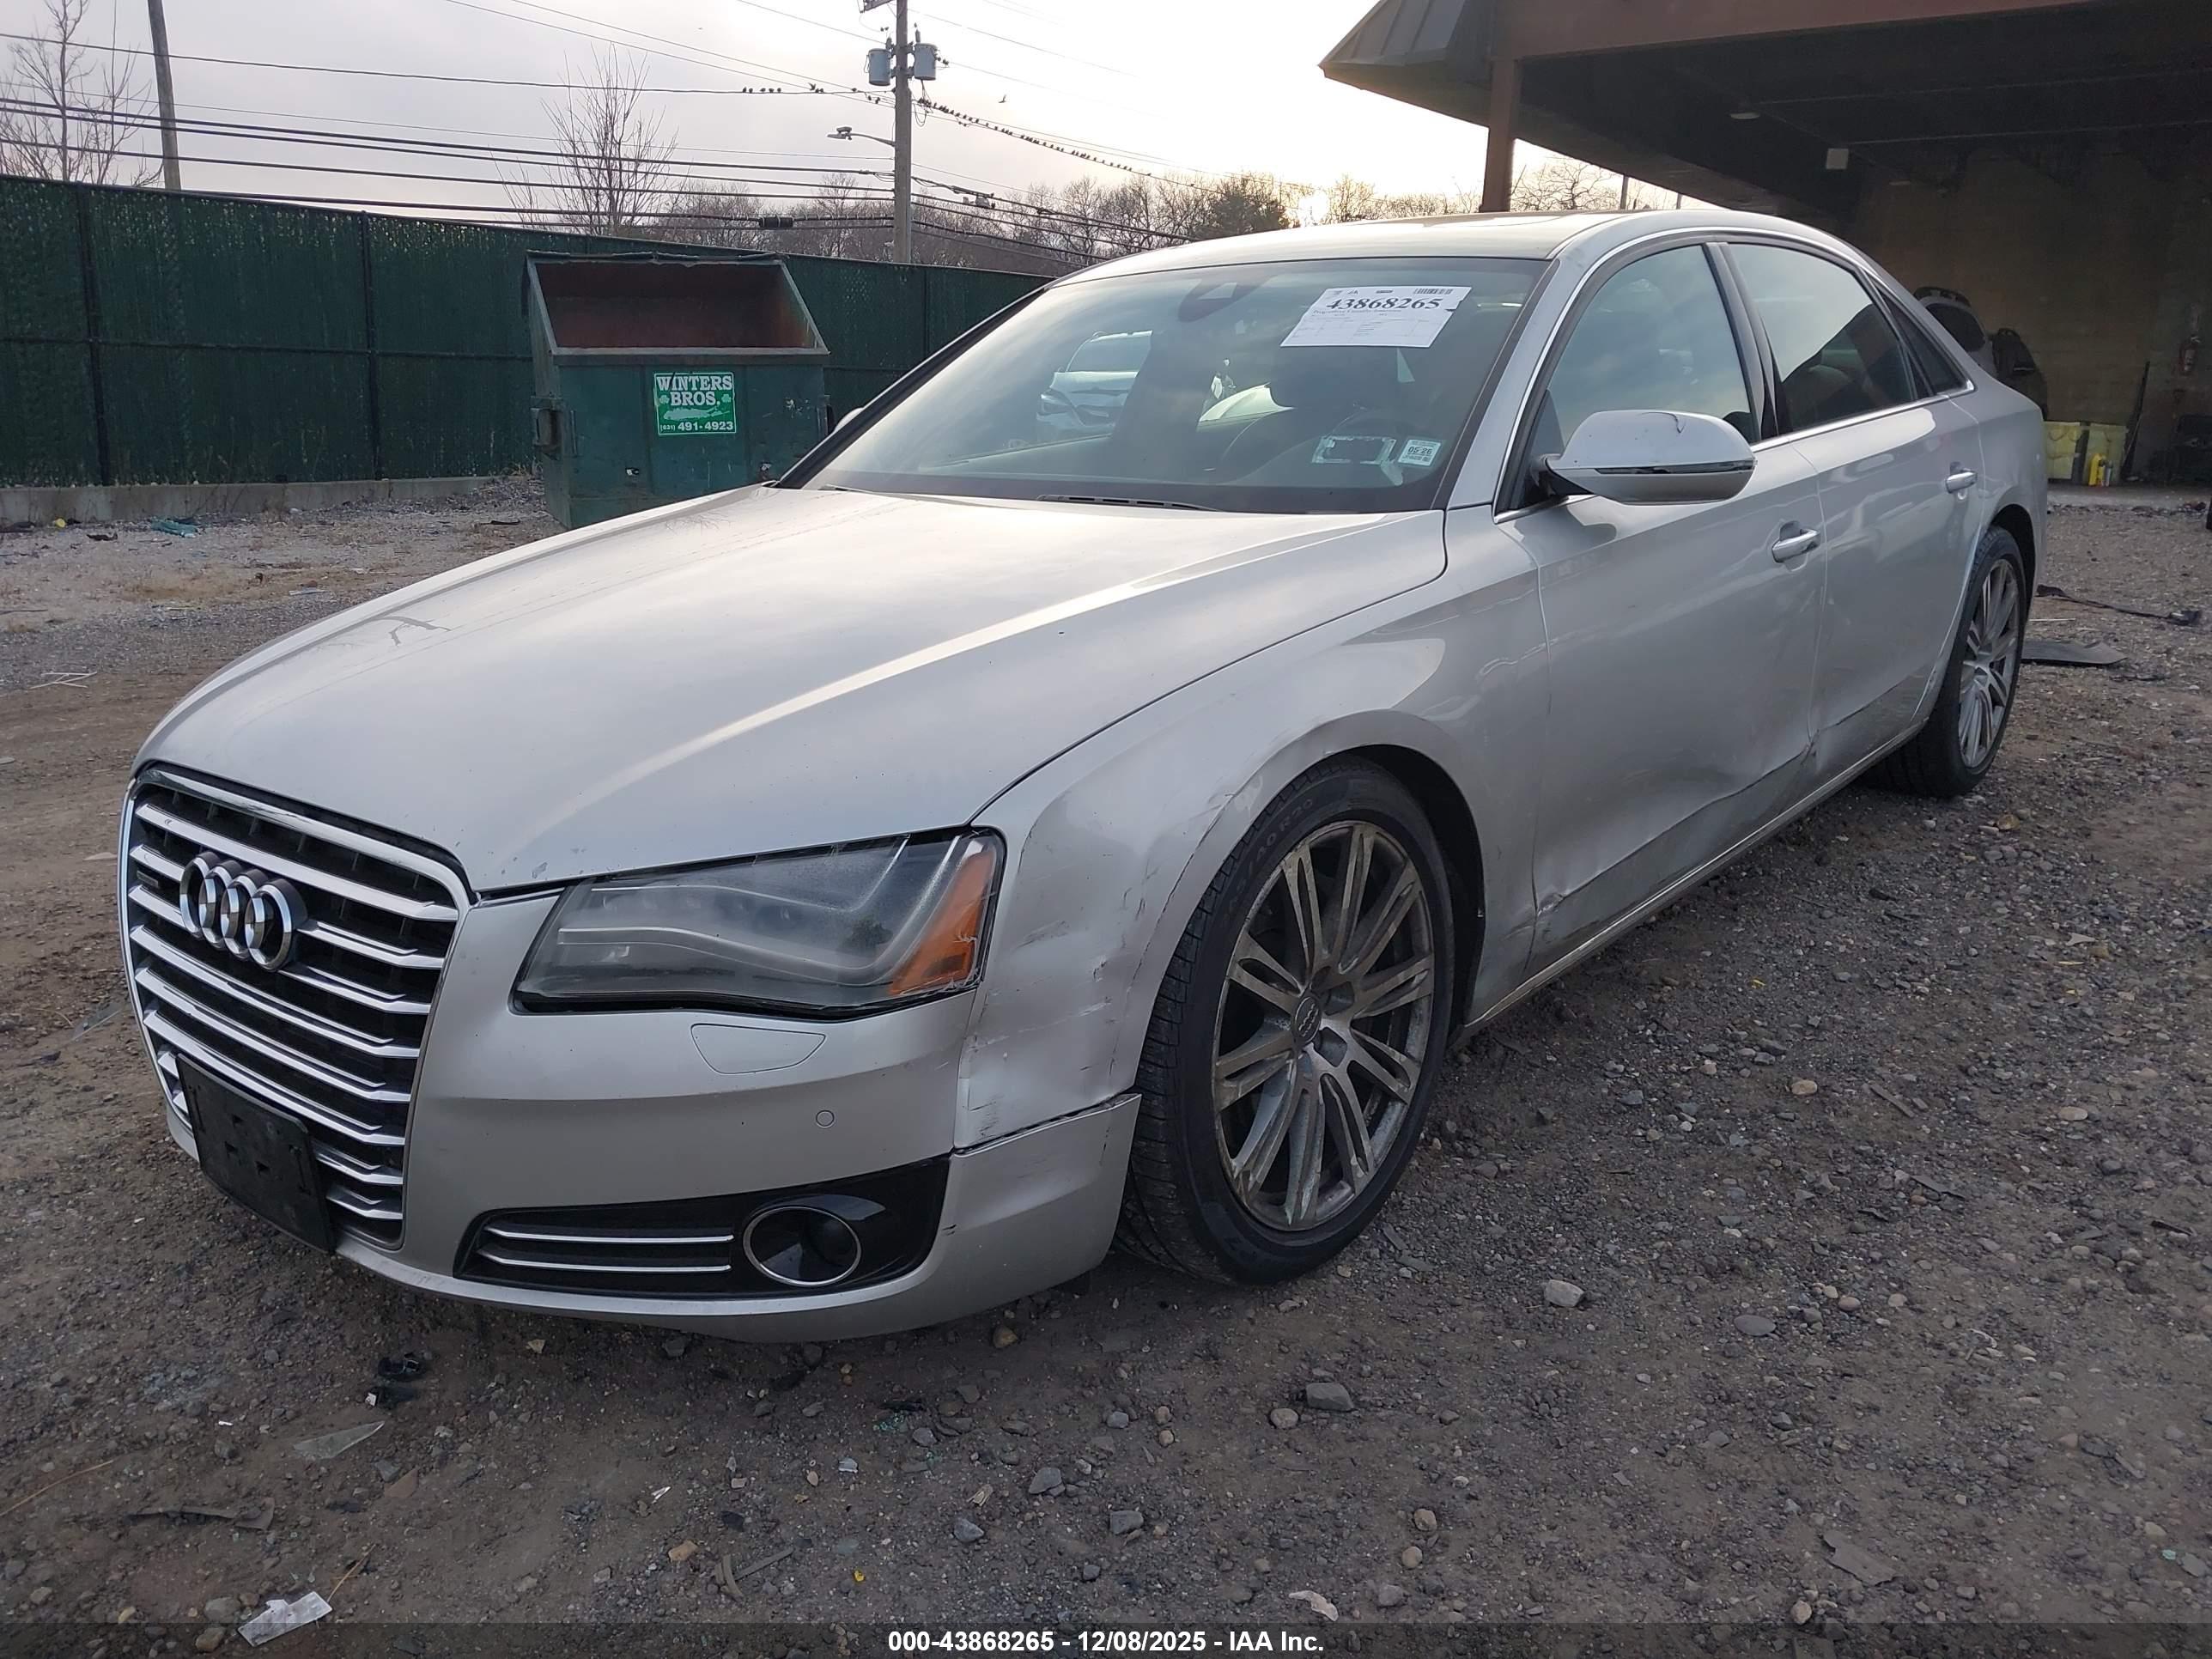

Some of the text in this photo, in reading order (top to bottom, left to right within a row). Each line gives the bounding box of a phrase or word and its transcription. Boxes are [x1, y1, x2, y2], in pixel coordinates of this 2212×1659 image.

[1326, 297, 1443, 310] 43868265
[656, 375, 732, 391] WINTERS
[670, 391, 720, 406] BROS.
